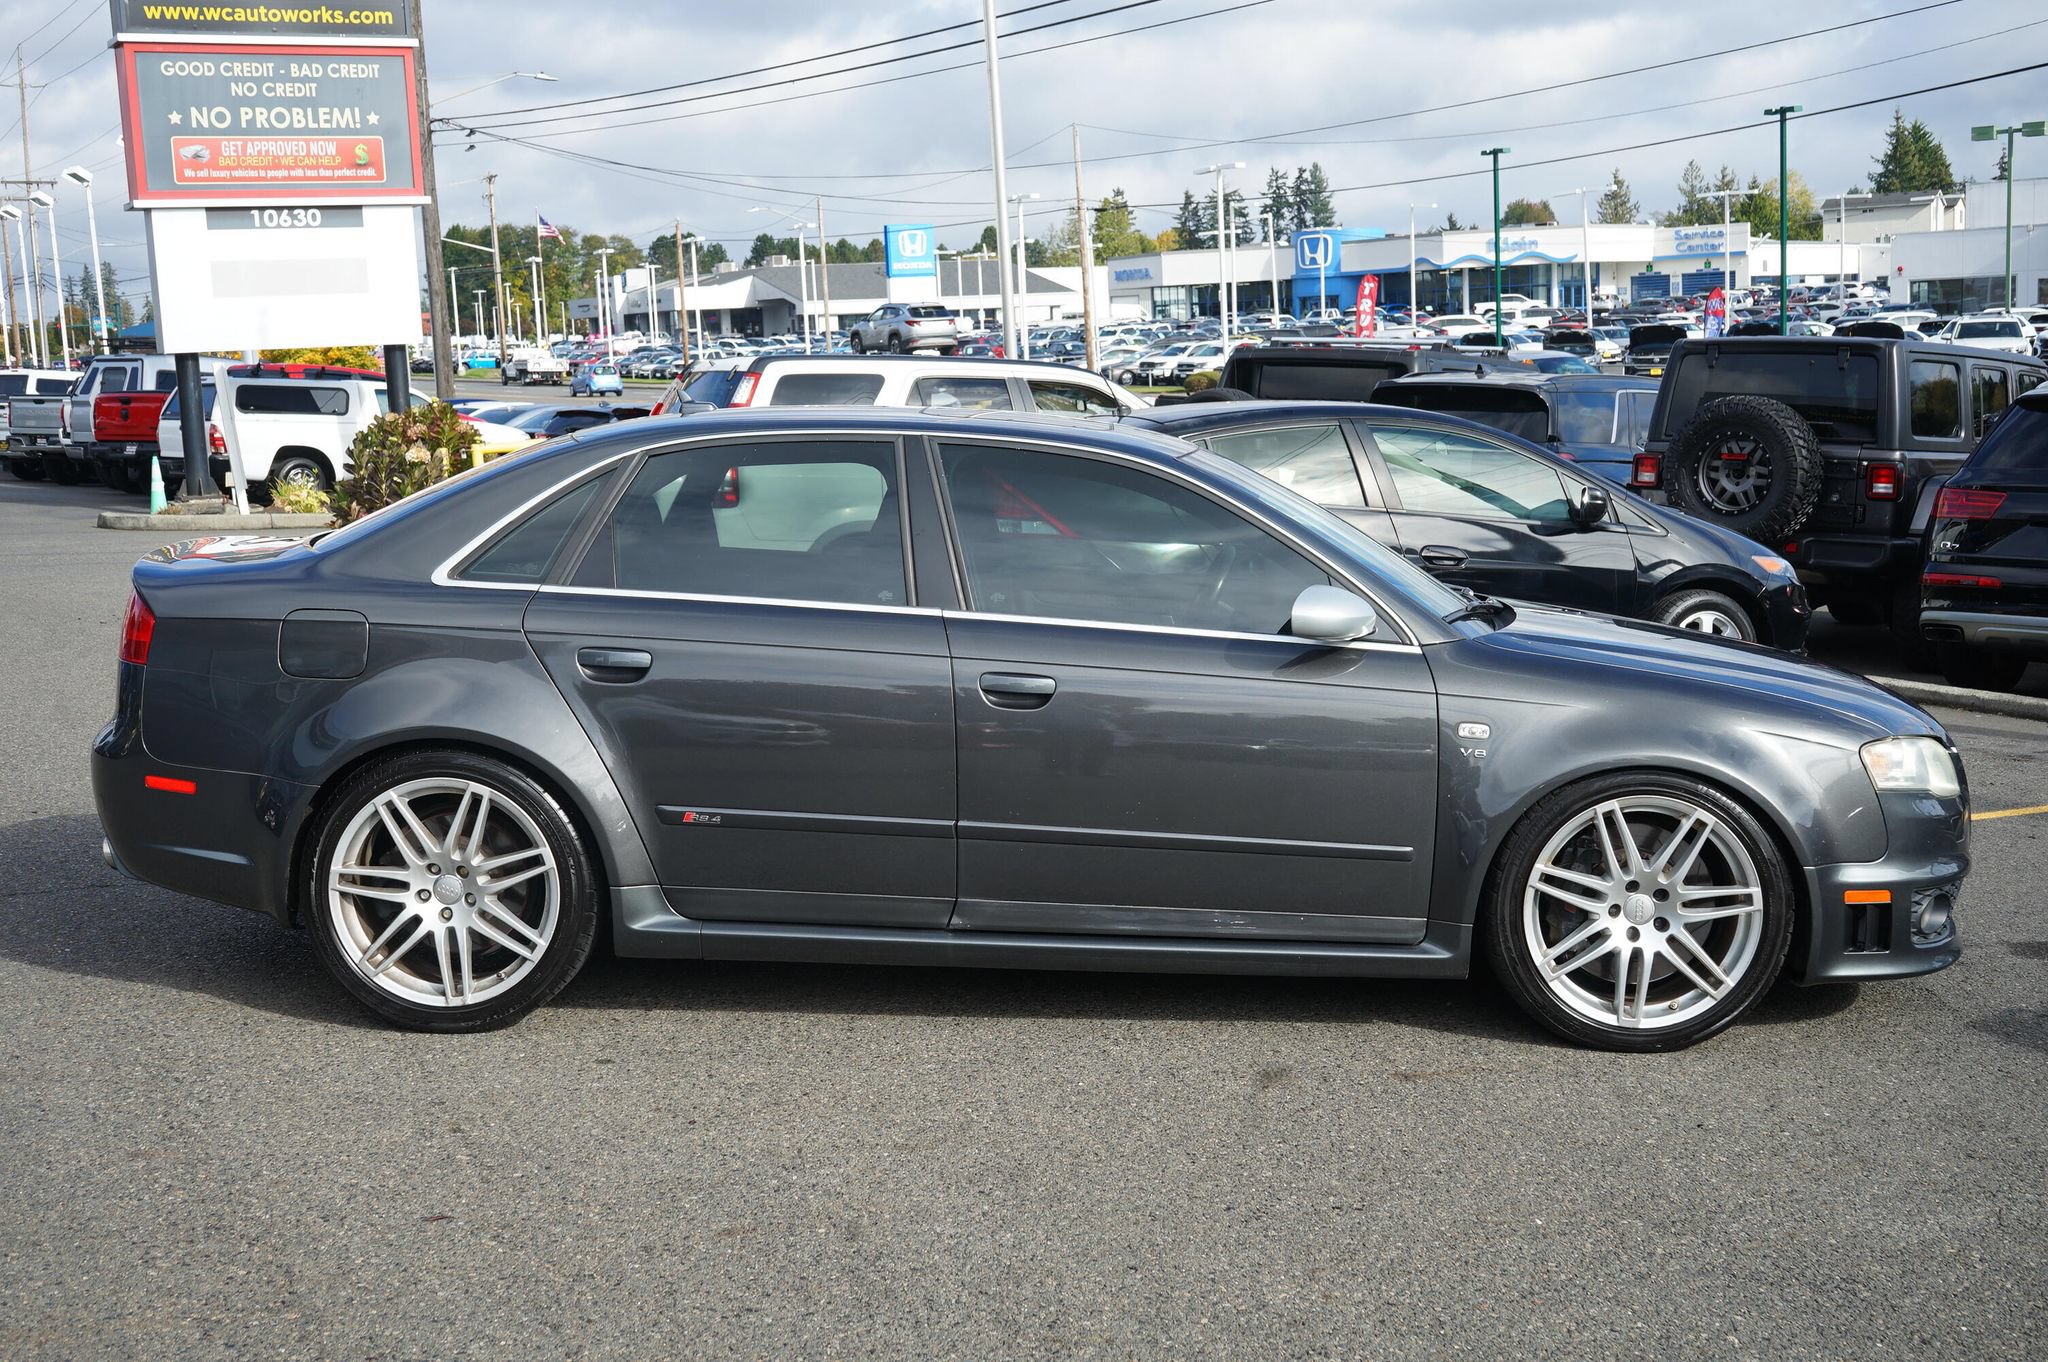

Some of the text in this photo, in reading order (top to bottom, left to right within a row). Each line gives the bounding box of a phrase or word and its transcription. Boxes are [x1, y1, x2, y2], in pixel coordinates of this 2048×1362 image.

[143, 5, 393, 24] www.wcautoworks.com
[160, 60, 215, 76] GOOD
[219, 62, 275, 77] CREDIT
[290, 63, 323, 77] BAD
[327, 63, 380, 78] CREDIT
[230, 82, 317, 97] NO CREDIT
[190, 106, 361, 129] NO PROBLEM!
[221, 141, 337, 156] GET APPROVED NOW
[218, 155, 342, 167] BAD CREDIT WE CAN HELP
[183, 166, 377, 179] We sell luxury vehicles to people with less than perfect credit.
[250, 208, 322, 228] 10630
[1674, 227, 1725, 241] Service
[1675, 239, 1725, 253] Center
[892, 261, 934, 270] HONDA
[1940, 541, 1960, 551] Q7
[1460, 747, 1487, 758] V8
